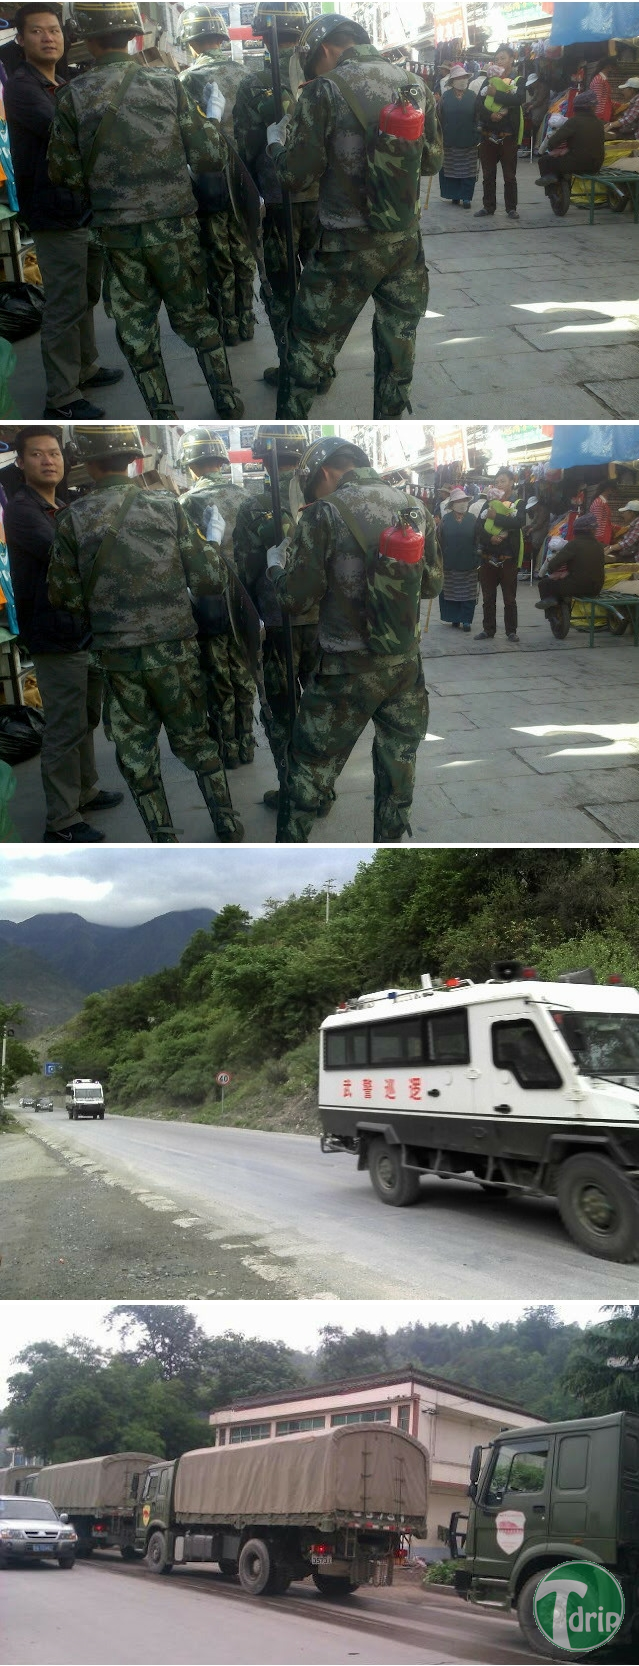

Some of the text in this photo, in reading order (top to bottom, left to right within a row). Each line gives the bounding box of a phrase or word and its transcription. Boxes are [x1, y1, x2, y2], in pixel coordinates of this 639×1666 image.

[219, 1075, 229, 1083] 40
[343, 1077, 422, 1100] 武警巡逻
